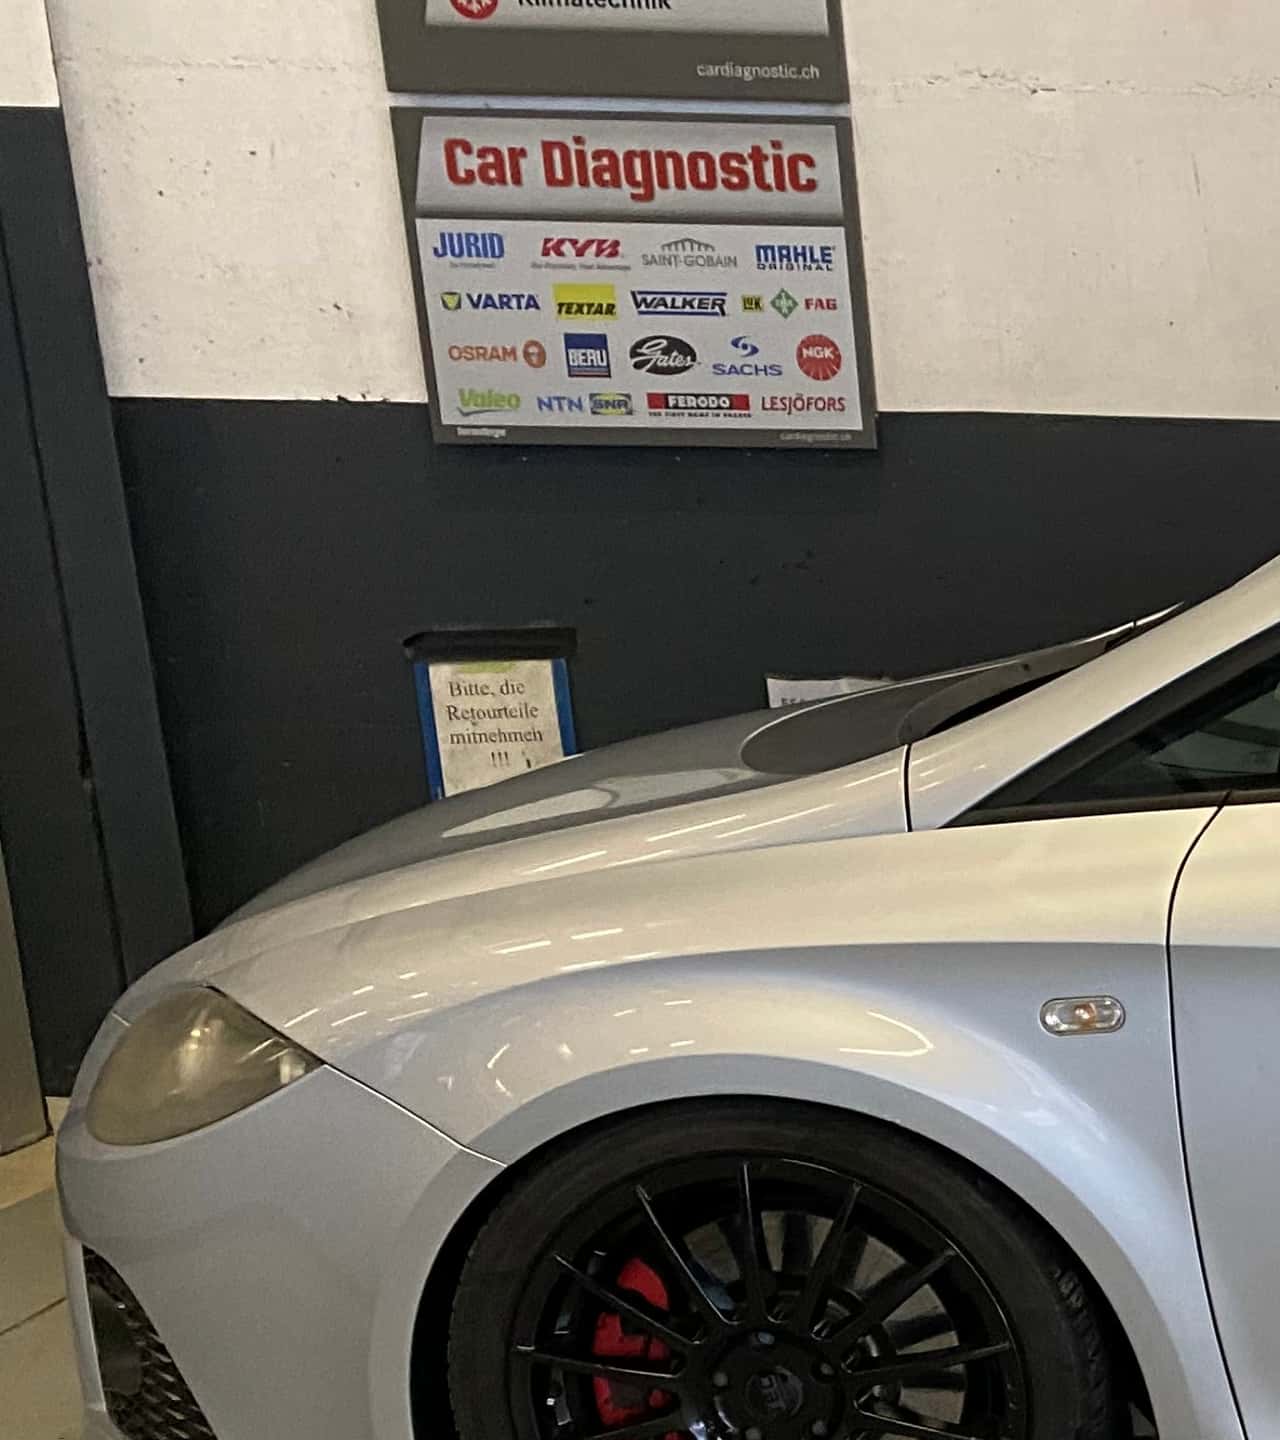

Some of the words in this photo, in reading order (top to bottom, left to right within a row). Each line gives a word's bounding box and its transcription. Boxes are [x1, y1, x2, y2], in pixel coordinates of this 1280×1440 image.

[697, 61, 820, 81] cardiagnostic.ch
[444, 138, 527, 186] Car
[541, 136, 818, 202] Diagnostic
[432, 232, 505, 258] JURID
[541, 238, 621, 257] KYB
[755, 244, 833, 263] MAHLE
[641, 253, 738, 268] SAINT-GOBAIN
[466, 293, 540, 310] VARTA
[557, 302, 616, 315] TEXTAR
[631, 291, 727, 316] WALKER
[804, 298, 838, 310] FAG
[448, 345, 517, 361] OSRAM
[568, 348, 608, 366] BERU
[630, 339, 697, 372] Gates
[802, 346, 835, 360] NGK
[712, 363, 783, 376] SACHS
[537, 396, 583, 412] NTN
[668, 395, 730, 409] FERODO
[762, 394, 846, 415] LESJÖFORS
[448, 681, 496, 697] Bitte,
[500, 680, 525, 695] die
[447, 702, 539, 721] Retourteile
